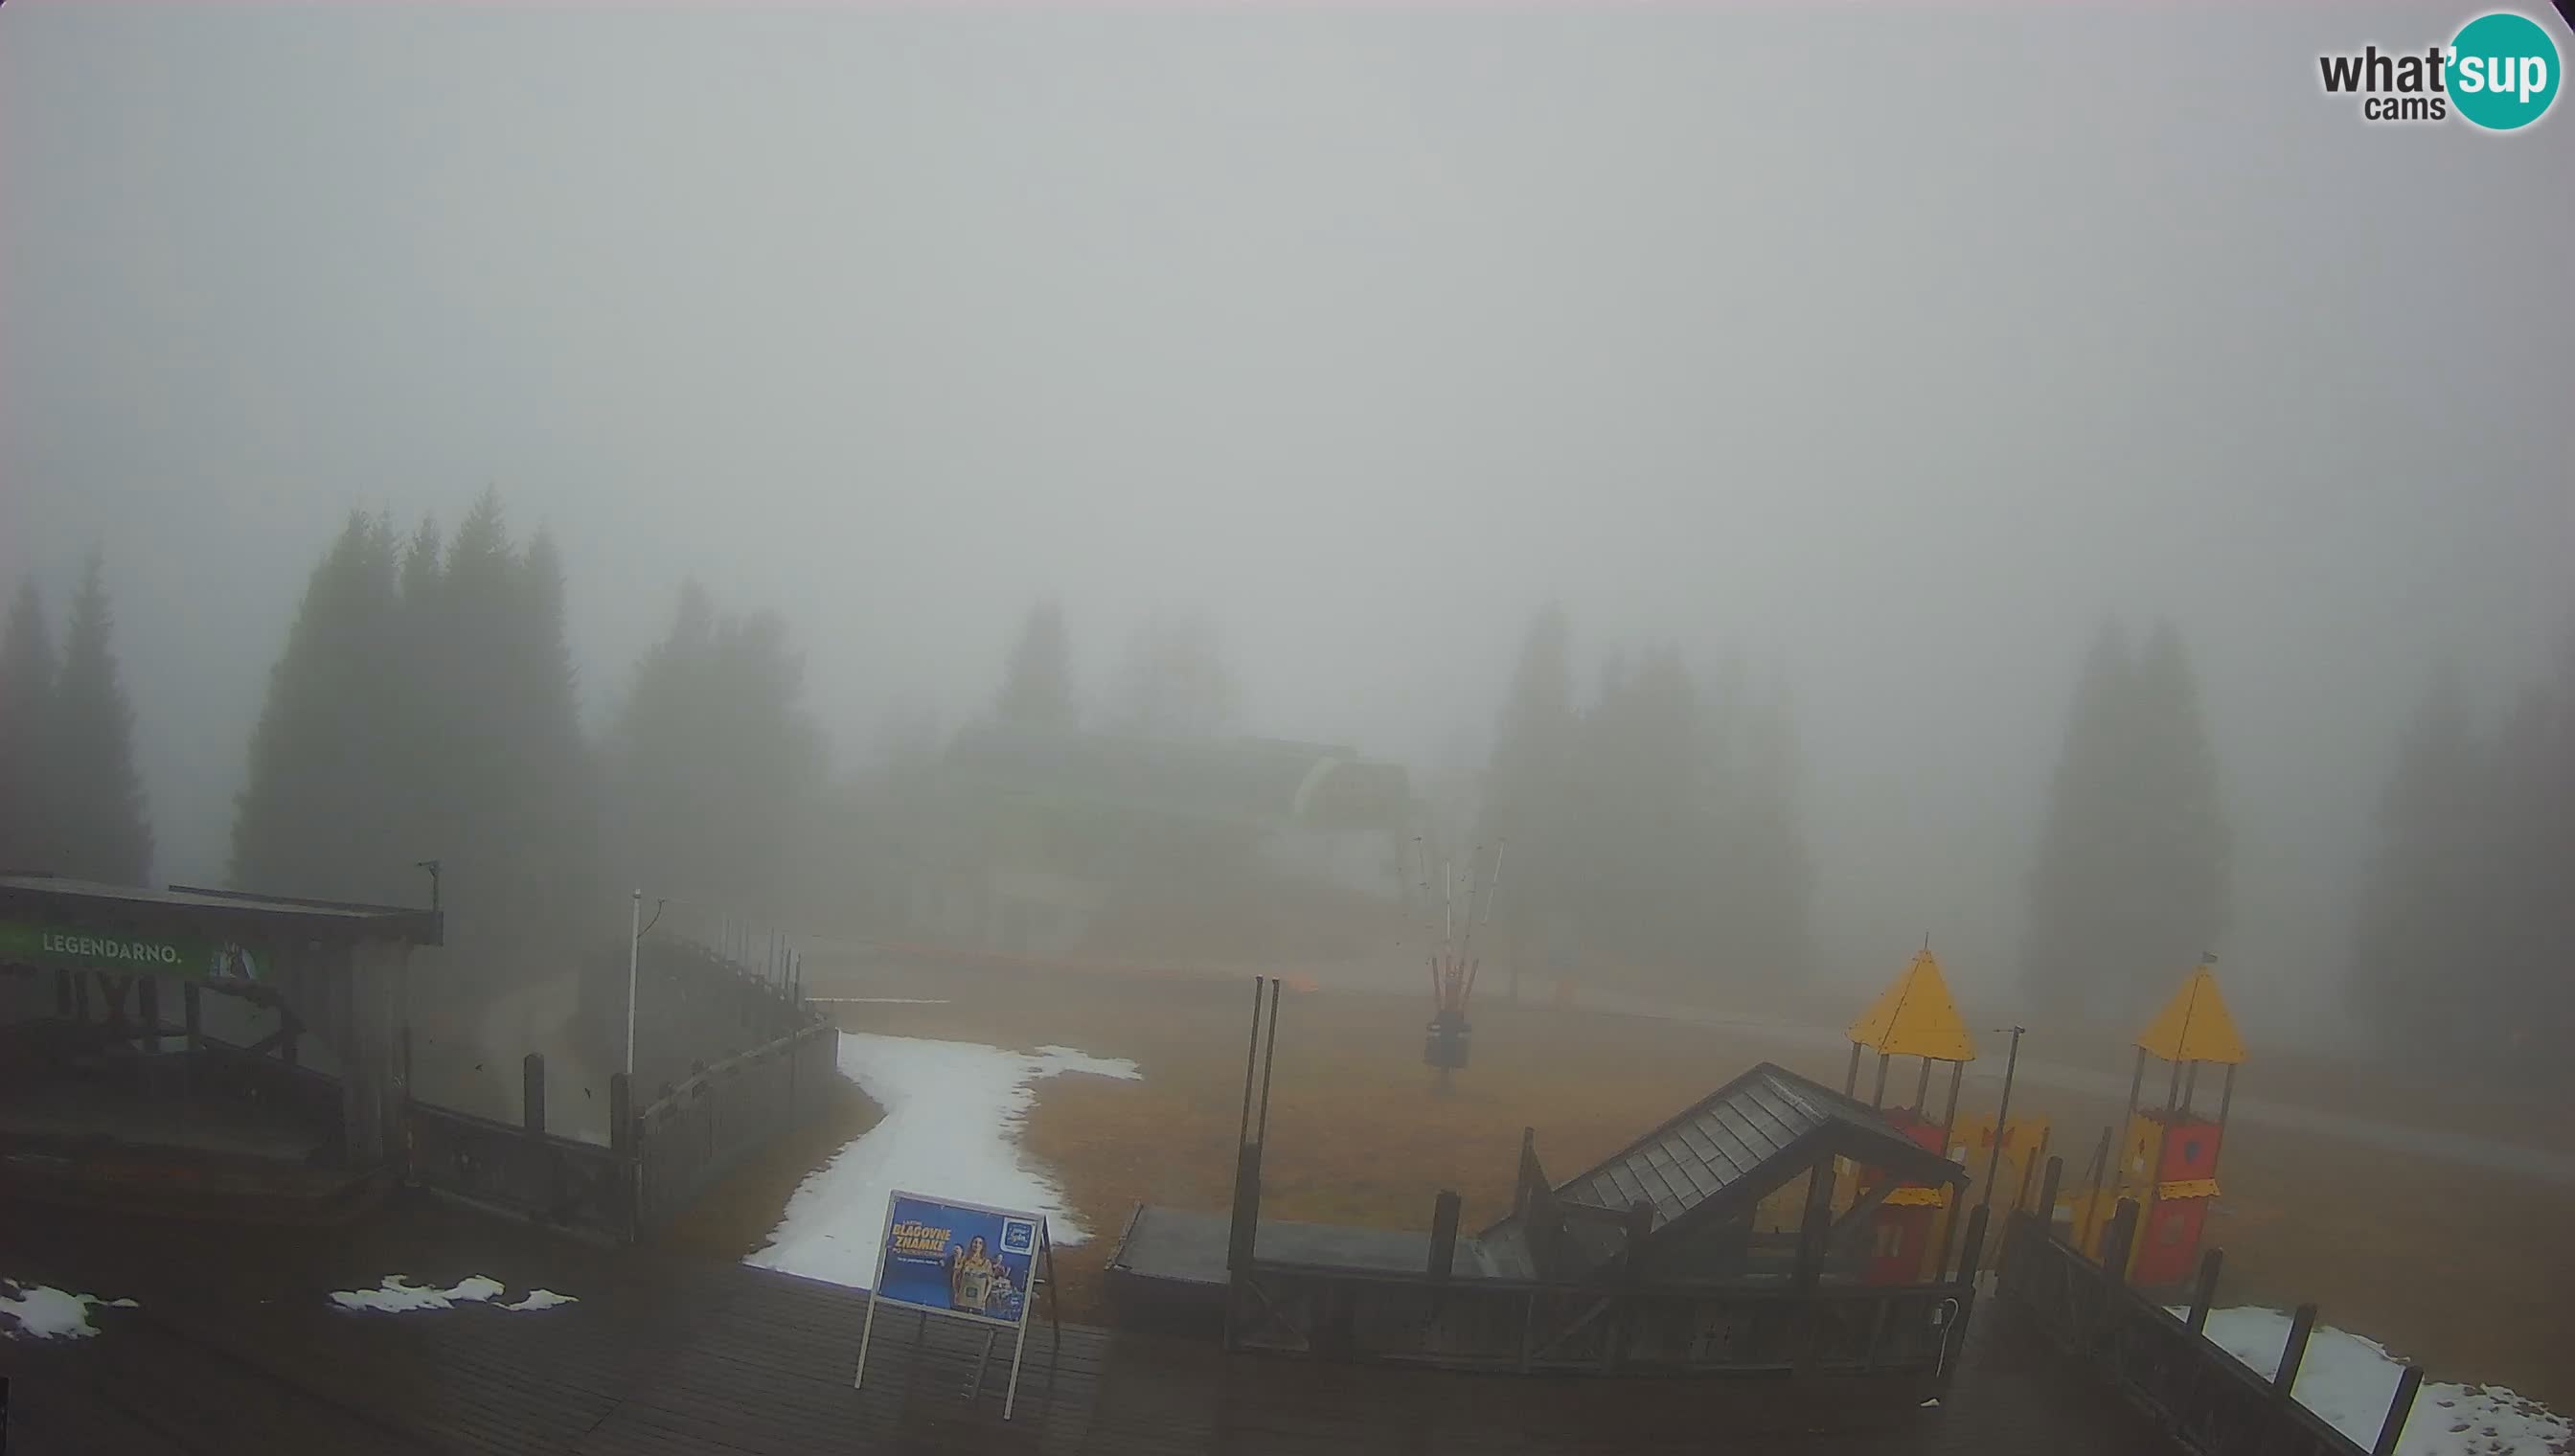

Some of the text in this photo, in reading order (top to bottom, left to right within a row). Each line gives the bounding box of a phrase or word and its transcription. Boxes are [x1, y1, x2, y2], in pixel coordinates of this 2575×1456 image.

[42, 932, 182, 964] LEGENDARNO.
[892, 1223, 951, 1241] BLAGOVNE
[895, 1236, 945, 1251] ZNAMKE
